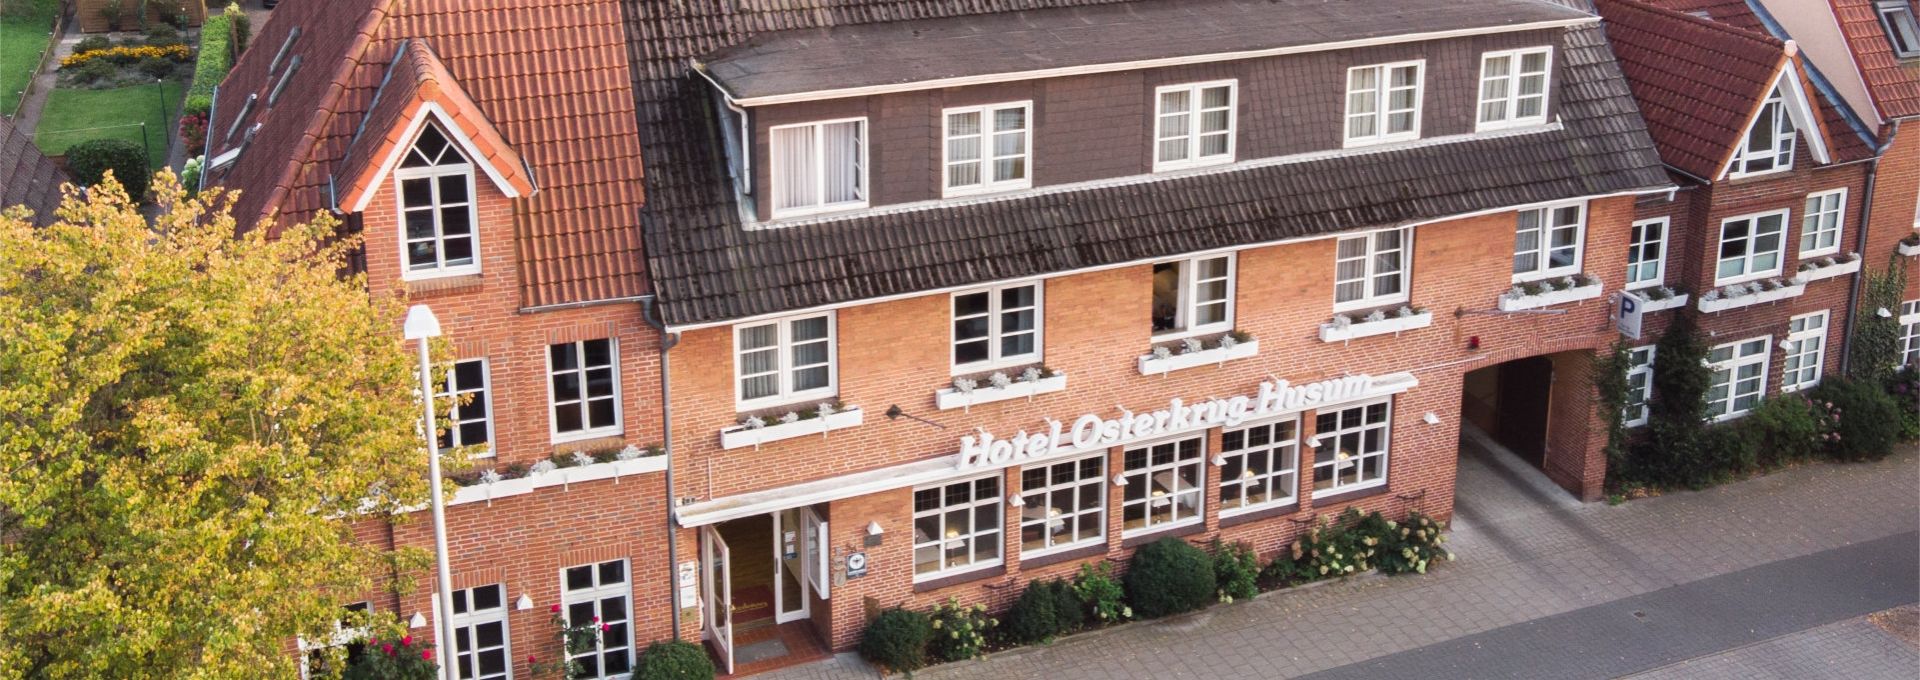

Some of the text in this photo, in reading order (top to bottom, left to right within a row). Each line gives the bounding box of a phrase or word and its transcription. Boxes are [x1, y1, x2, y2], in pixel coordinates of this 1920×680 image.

[1621, 296, 1634, 319] P
[959, 374, 1372, 470] Hotel Osterkrug Husum
